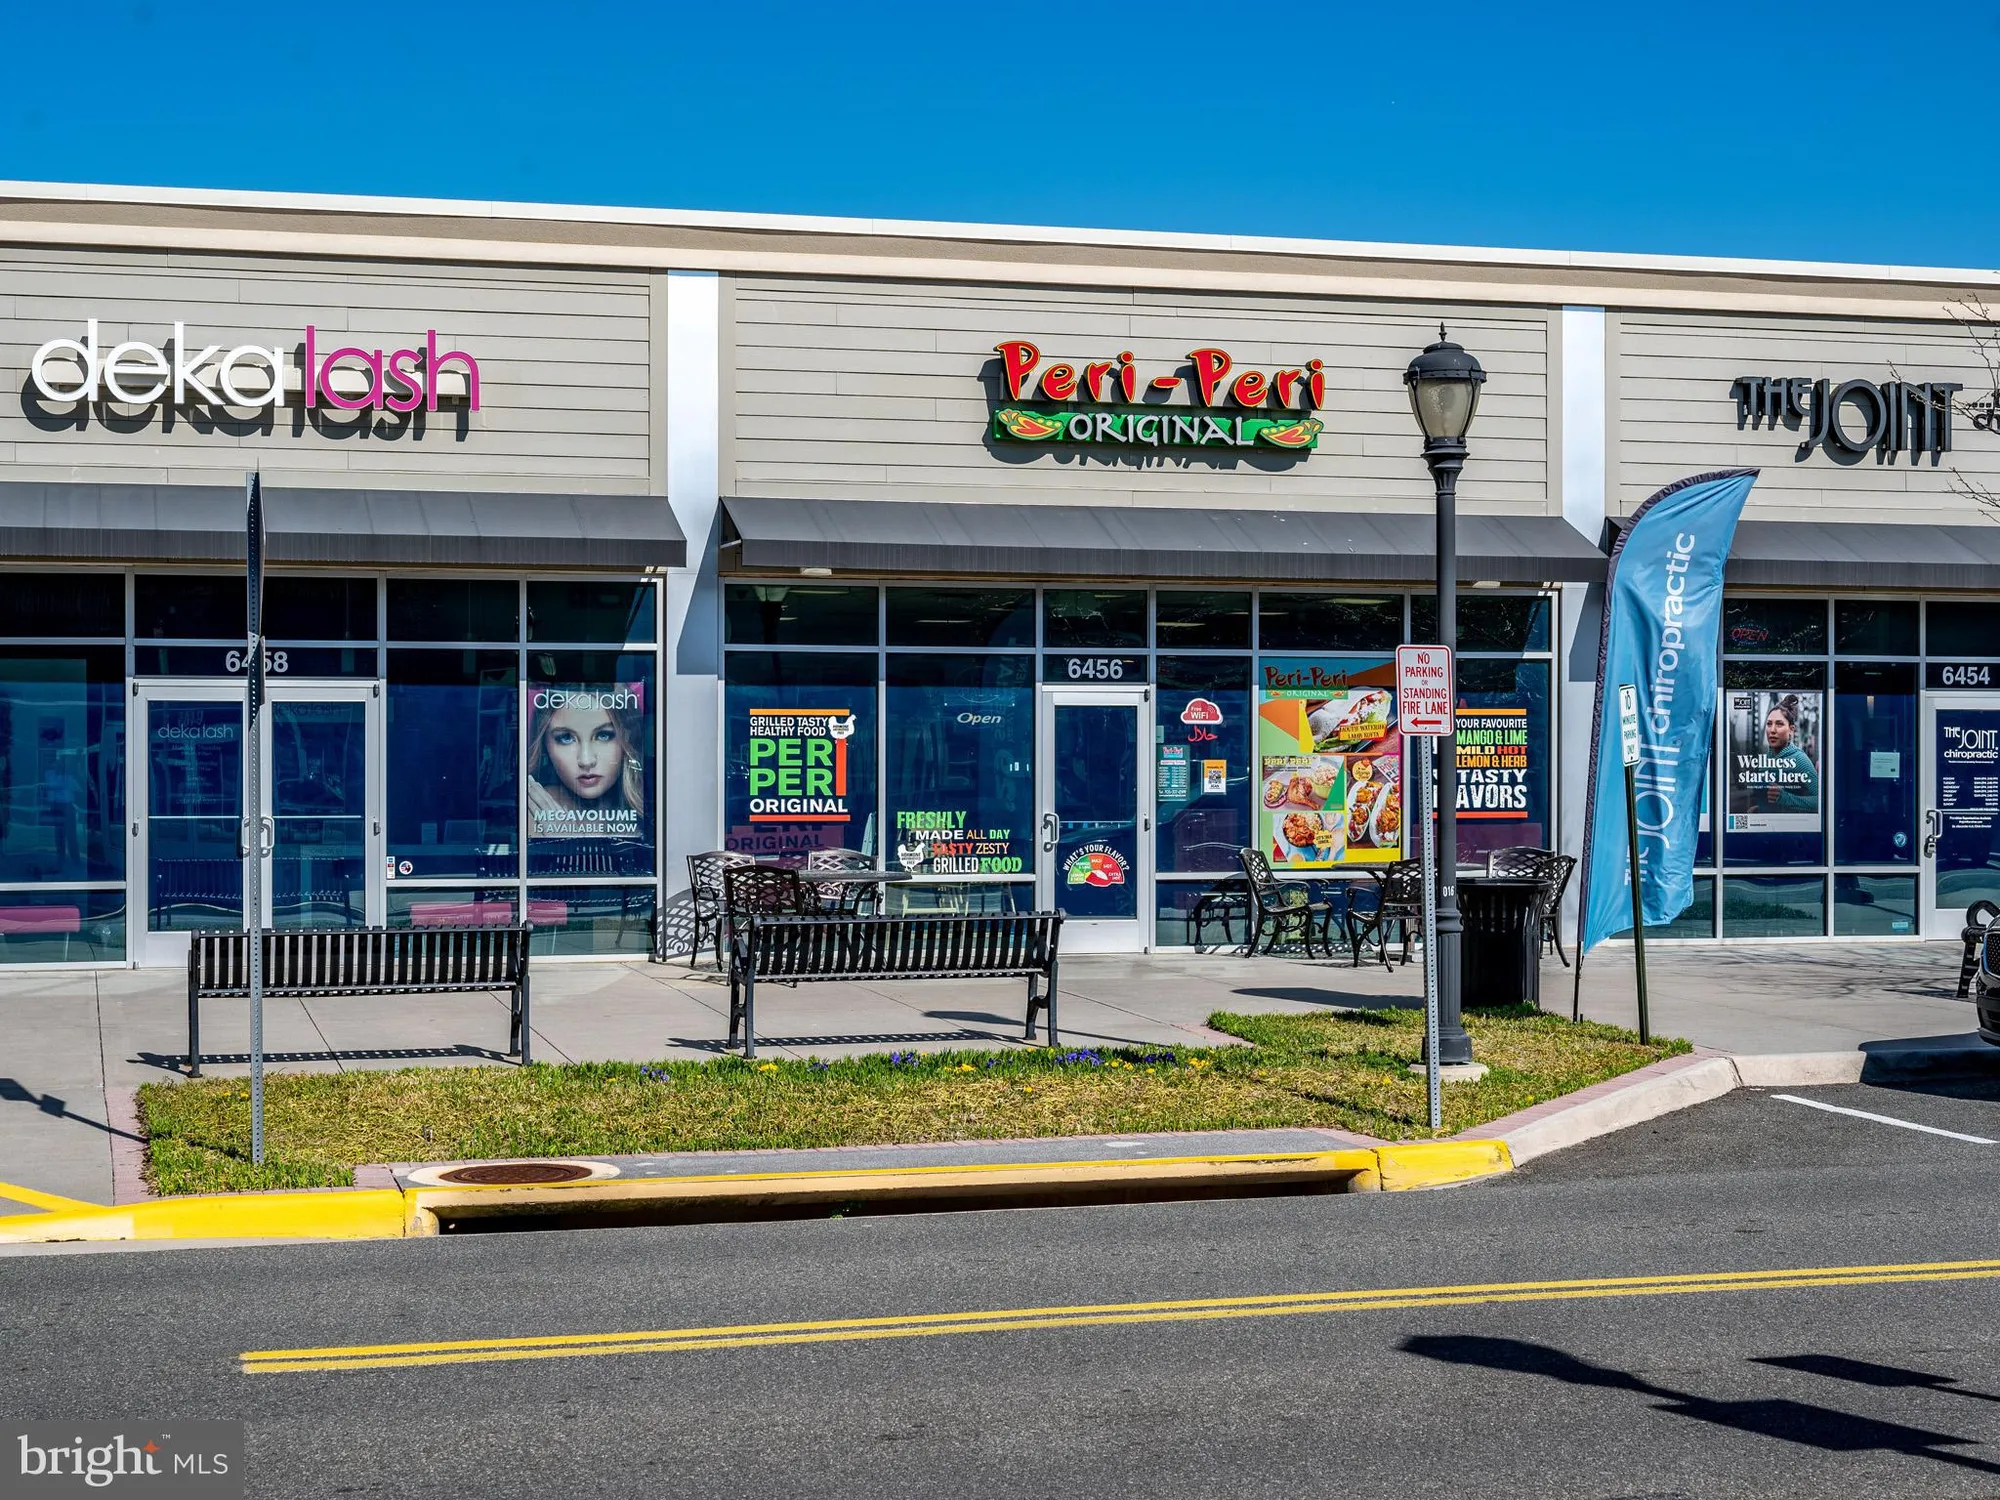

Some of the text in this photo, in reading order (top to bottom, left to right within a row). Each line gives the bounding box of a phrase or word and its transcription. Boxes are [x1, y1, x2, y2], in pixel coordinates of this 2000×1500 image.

[31, 318, 480, 413] deka lash
[993, 341, 1326, 410] Peri-Peri
[1736, 377, 1812, 417] THE
[1799, 378, 1964, 452] JOINT
[1068, 412, 1255, 447] ORIGINAL
[1646, 531, 1696, 735] chiropractic
[1417, 653, 1430, 665] NO
[1067, 658, 1123, 679] 6456
[1405, 666, 1444, 678] PARKING
[1942, 666, 1991, 685] 6454
[1264, 666, 1348, 688] Peri-Peri
[534, 689, 638, 710] deka lash
[1403, 688, 1447, 700] STANDING
[1403, 701, 1448, 715] FIRE LANE
[750, 717, 828, 727] GRILLED TASTY
[957, 712, 1001, 726] Open
[1456, 719, 1527, 728] YOUR FAVOURITE
[158, 723, 200, 738] deka
[750, 727, 794, 736] HEALTHY
[797, 727, 826, 736] FOOD
[1456, 730, 1492, 745] MANGO
[1494, 730, 1504, 745] &
[1505, 730, 1528, 745] LIME
[1456, 746, 1527, 755] MILD HOT
[1943, 750, 1998, 760] chiropractic
[1456, 755, 1527, 768] LEMON & HERB
[1737, 754, 1797, 768] Wellness
[1457, 769, 1526, 783] TASTY
[1738, 769, 1811, 783] starts here.
[1433, 785, 1526, 808] AVORS
[750, 799, 848, 813] ORIGINAL
[533, 809, 637, 821] MEGAVOLUME
[897, 811, 967, 829] FRESHLY
[534, 823, 637, 833] IS AVAILABLE NOW
[915, 829, 1010, 840] MADE ALL DAY
[932, 842, 1010, 855] TASTY ZESTY
[933, 856, 1023, 873] GRILLED FOOD
[1062, 844, 1130, 871] WHAT'S YOUR FLAVOR?
